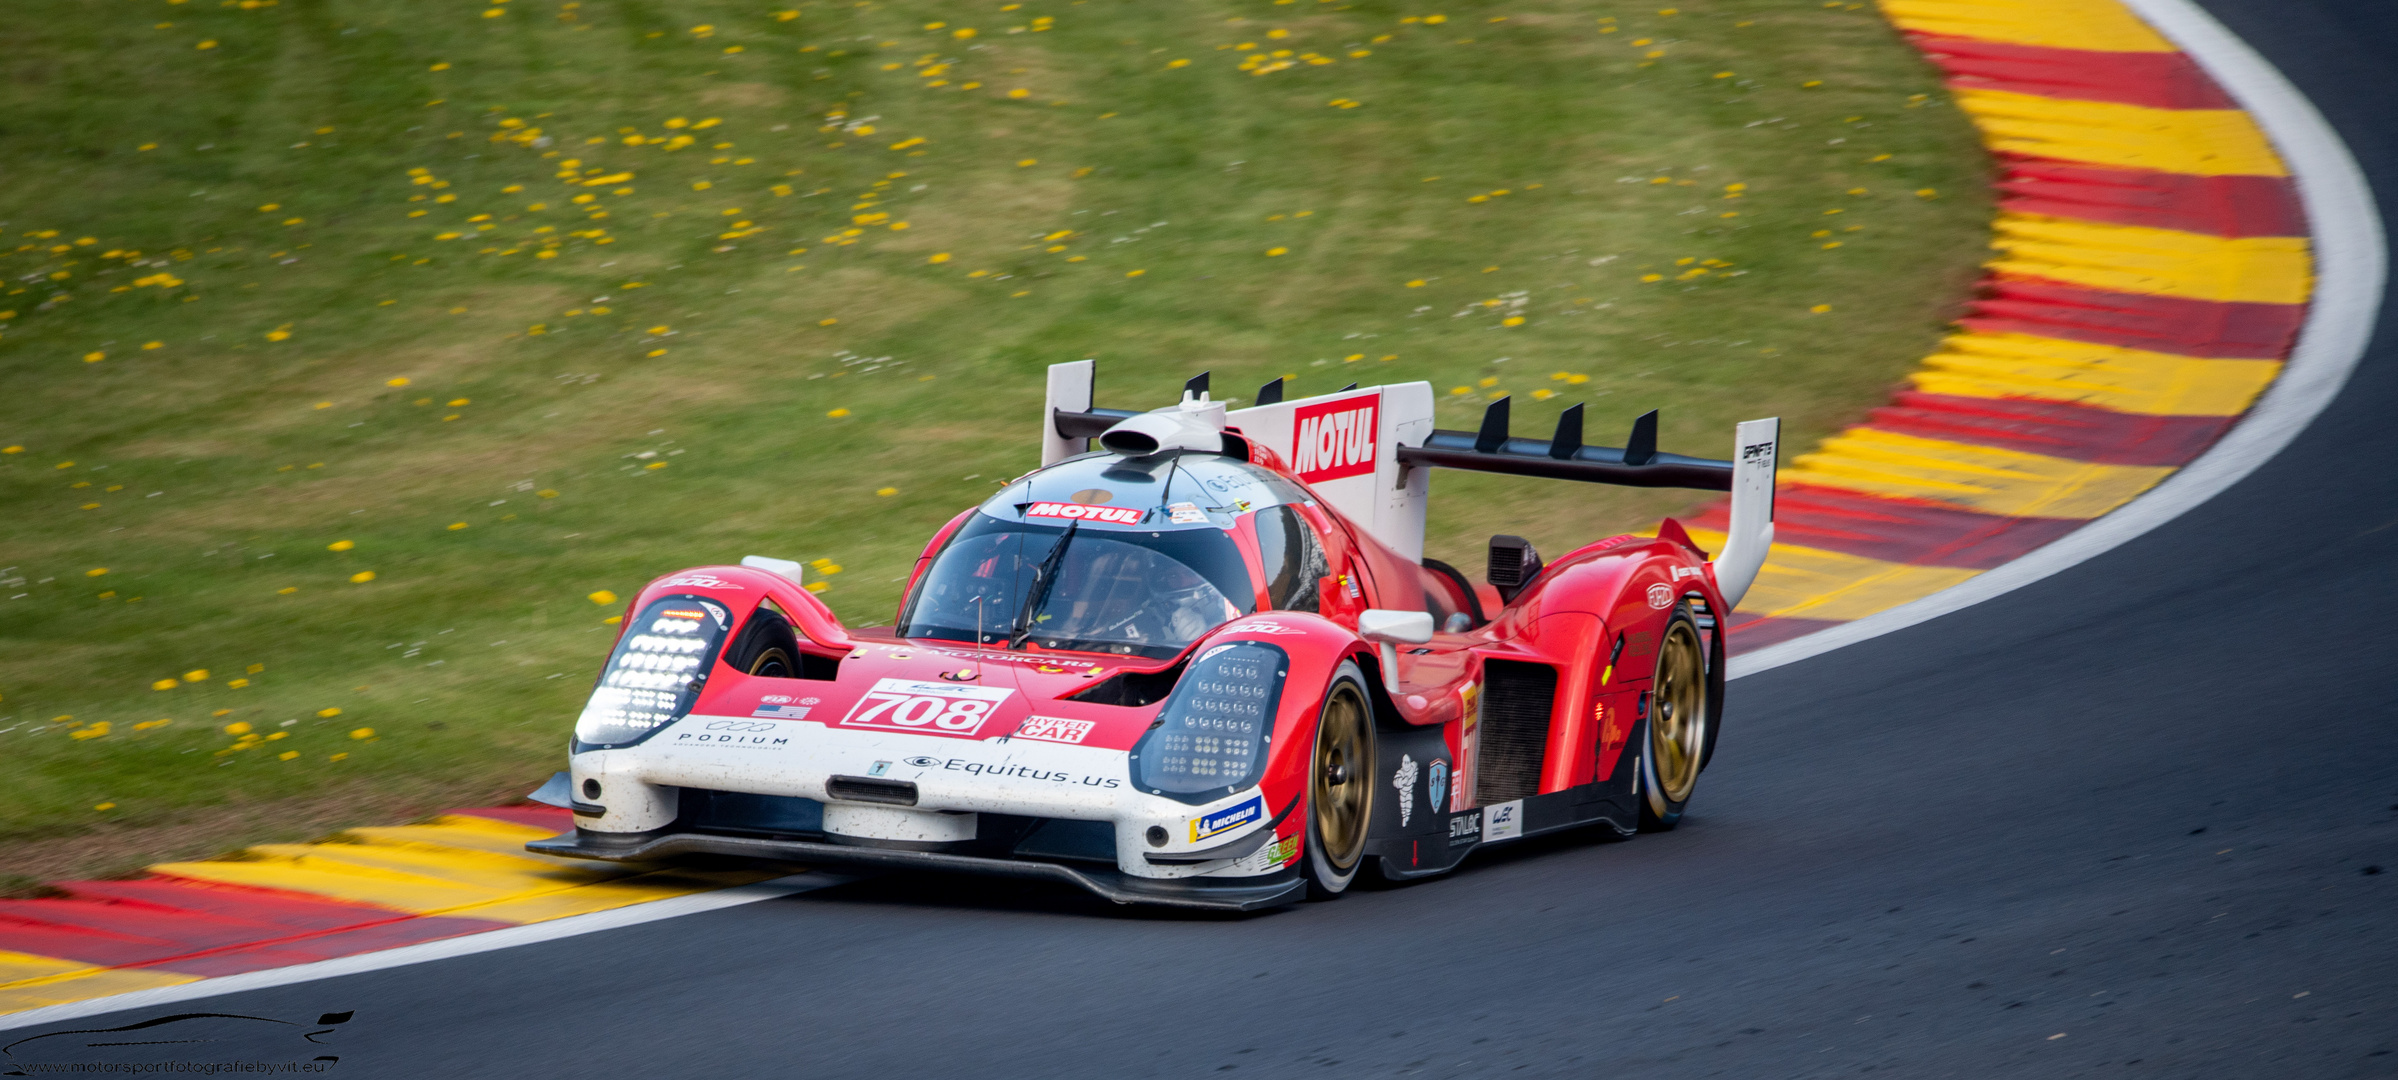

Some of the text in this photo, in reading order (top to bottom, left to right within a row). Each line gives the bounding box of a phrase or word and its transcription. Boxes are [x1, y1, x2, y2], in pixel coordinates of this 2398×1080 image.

[1295, 407, 1374, 474] MOTUL
[1029, 503, 1138, 523] MOTUL
[928, 649, 1096, 667] MOTORCARS
[854, 692, 990, 730] 708
[1020, 723, 1084, 741] CAR
[1028, 716, 1089, 730] HYPER
[678, 733, 789, 746] PODIUM
[944, 757, 1121, 789] Equitus.us
[1211, 805, 1256, 830] MICHELIN
[1267, 834, 1299, 859] GREEN
